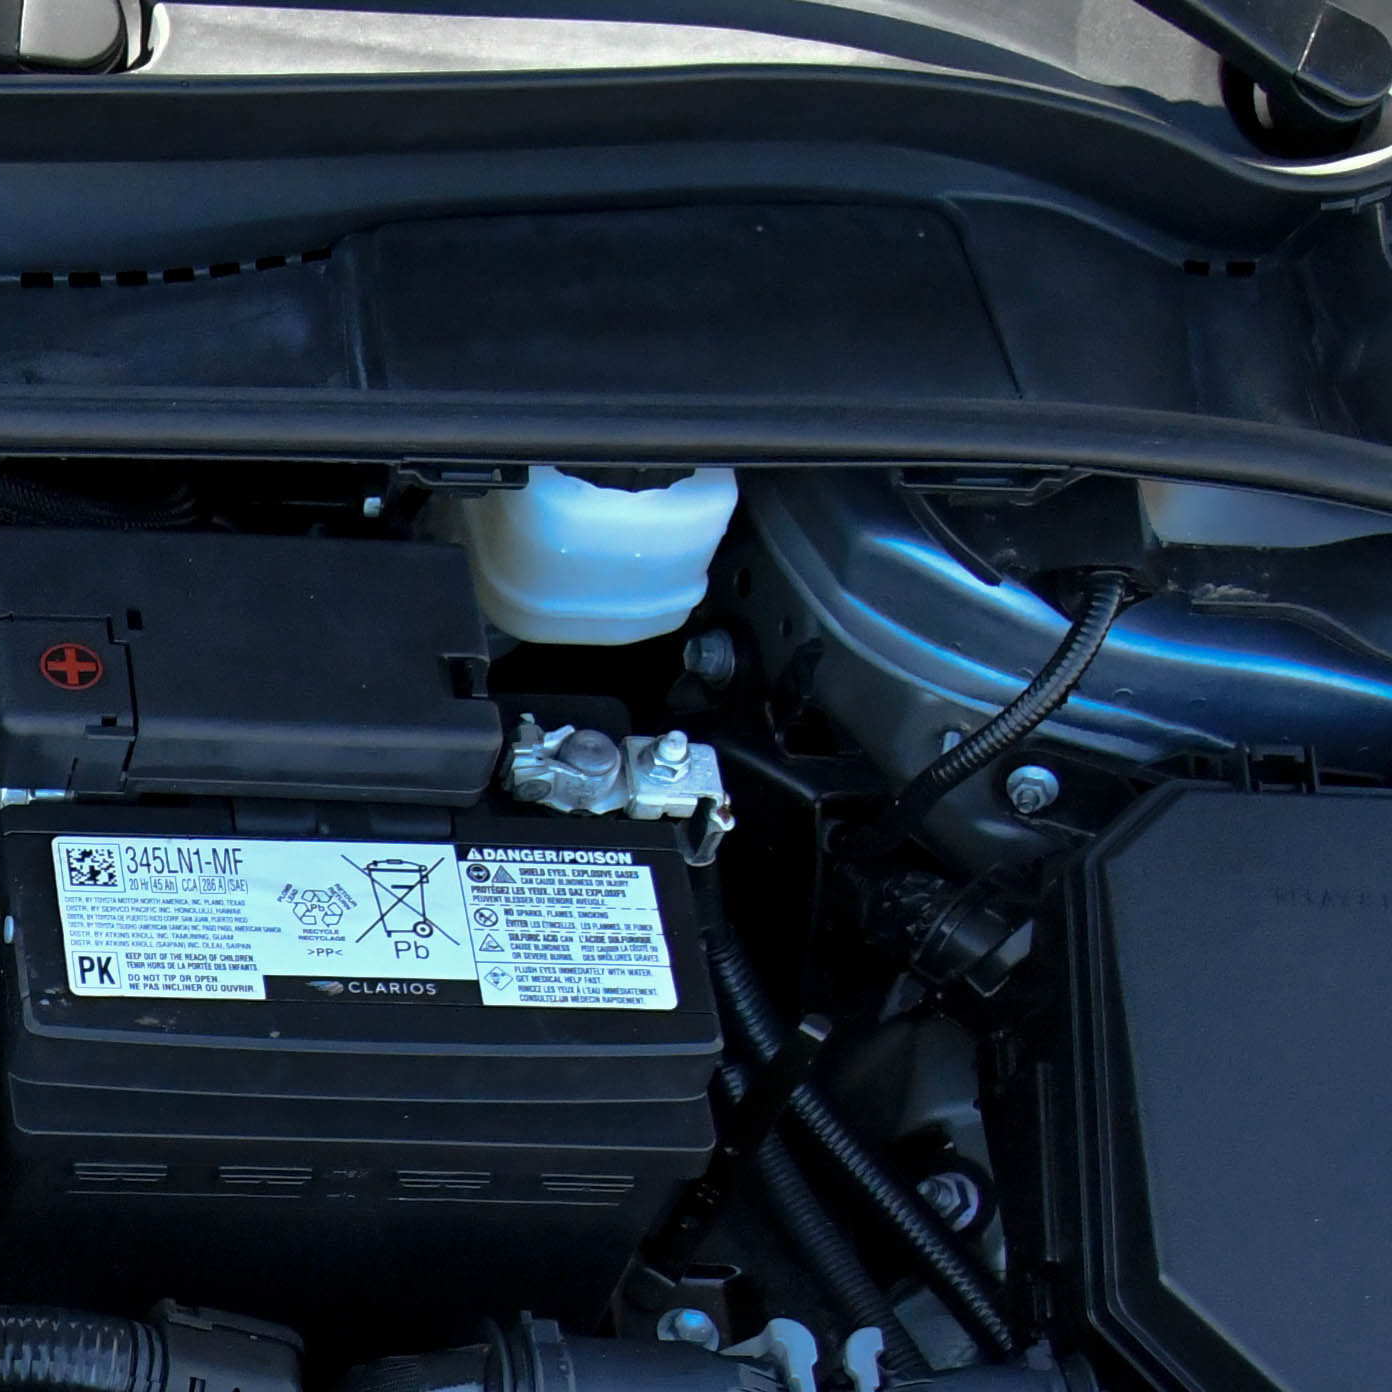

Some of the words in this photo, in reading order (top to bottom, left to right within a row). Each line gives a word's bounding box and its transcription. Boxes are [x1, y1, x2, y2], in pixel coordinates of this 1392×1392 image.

[126, 846, 243, 875] 345LN1-MF
[482, 849, 632, 865] DANGER/POISON
[129, 878, 138, 890] 20
[153, 878, 163, 890] 45
[181, 878, 198, 891] CCA
[202, 879, 217, 891] 286
[310, 903, 325, 912] Pb
[308, 947, 343, 957] >PP<
[394, 940, 430, 960] Pb
[125, 952, 142, 960] KEEP
[144, 952, 157, 961] OUT
[159, 953, 168, 961] OF
[170, 953, 183, 961] THE
[184, 953, 207, 962] REACH
[209, 953, 218, 962] OF
[78, 955, 116, 985] PK
[177, 962, 186, 970] LA
[128, 974, 140, 982] DO
[143, 974, 160, 983] NOT
[163, 974, 177, 983] TIP
[179, 974, 192, 983] OR
[129, 983, 141, 991] NE
[143, 983, 160, 991] PAS
[162, 983, 203, 992] INCLINER
[205, 984, 218, 992] OU
[348, 981, 437, 996] CLARIOS
